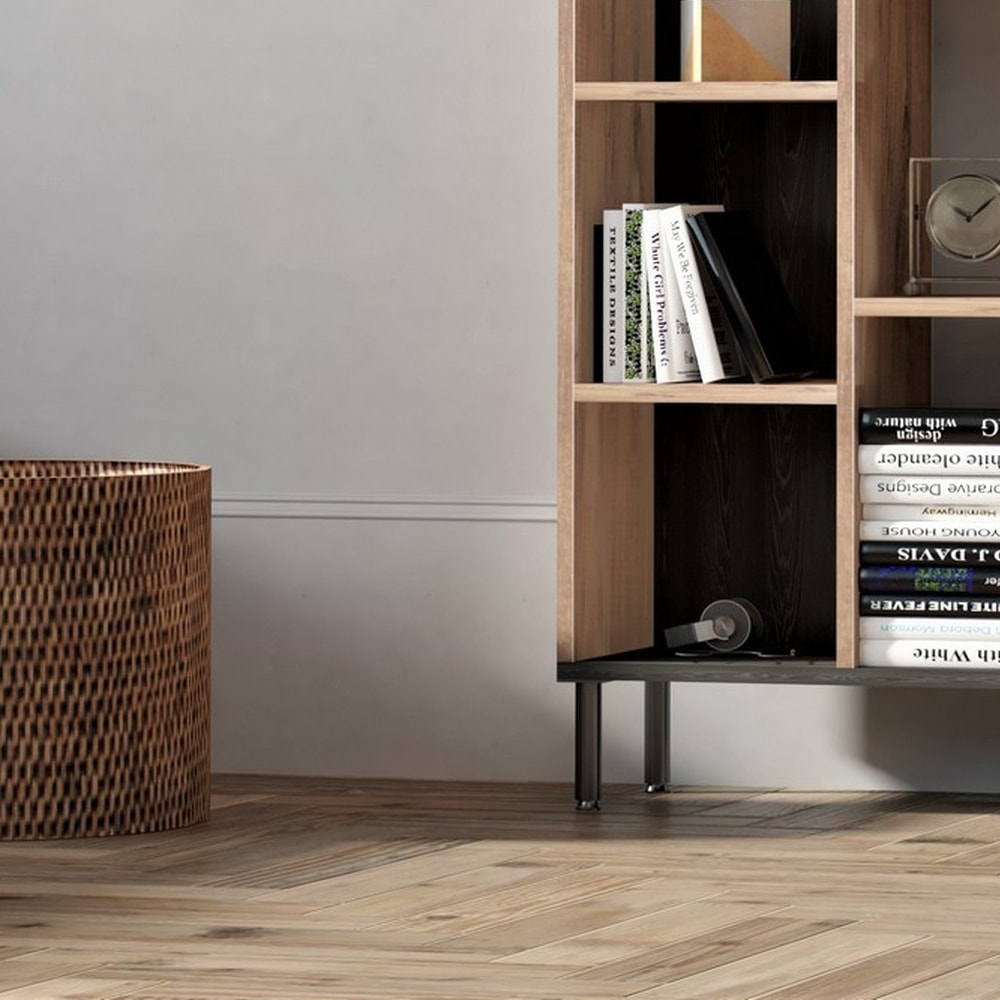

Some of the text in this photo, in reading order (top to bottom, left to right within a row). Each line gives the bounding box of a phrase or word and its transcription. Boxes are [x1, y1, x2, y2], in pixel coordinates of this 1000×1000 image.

[670, 220, 682, 241] May
[676, 242, 687, 259] We
[679, 261, 690, 273] Be
[653, 274, 664, 299] Girl
[683, 273, 700, 316] Forgiven
[655, 301, 668, 355] Problems
[874, 417, 957, 430] with nature
[896, 428, 942, 443] design
[877, 453, 961, 469] oleander
[877, 480, 942, 497] Designs
[921, 507, 996, 518] Hemingway
[881, 526, 1000, 538] YOUNG HOUSE
[896, 547, 966, 562] DAVIS
[972, 548, 990, 563] J.
[870, 600, 924, 611] FEVER
[928, 601, 969, 612] LINE
[912, 647, 971, 662] White
